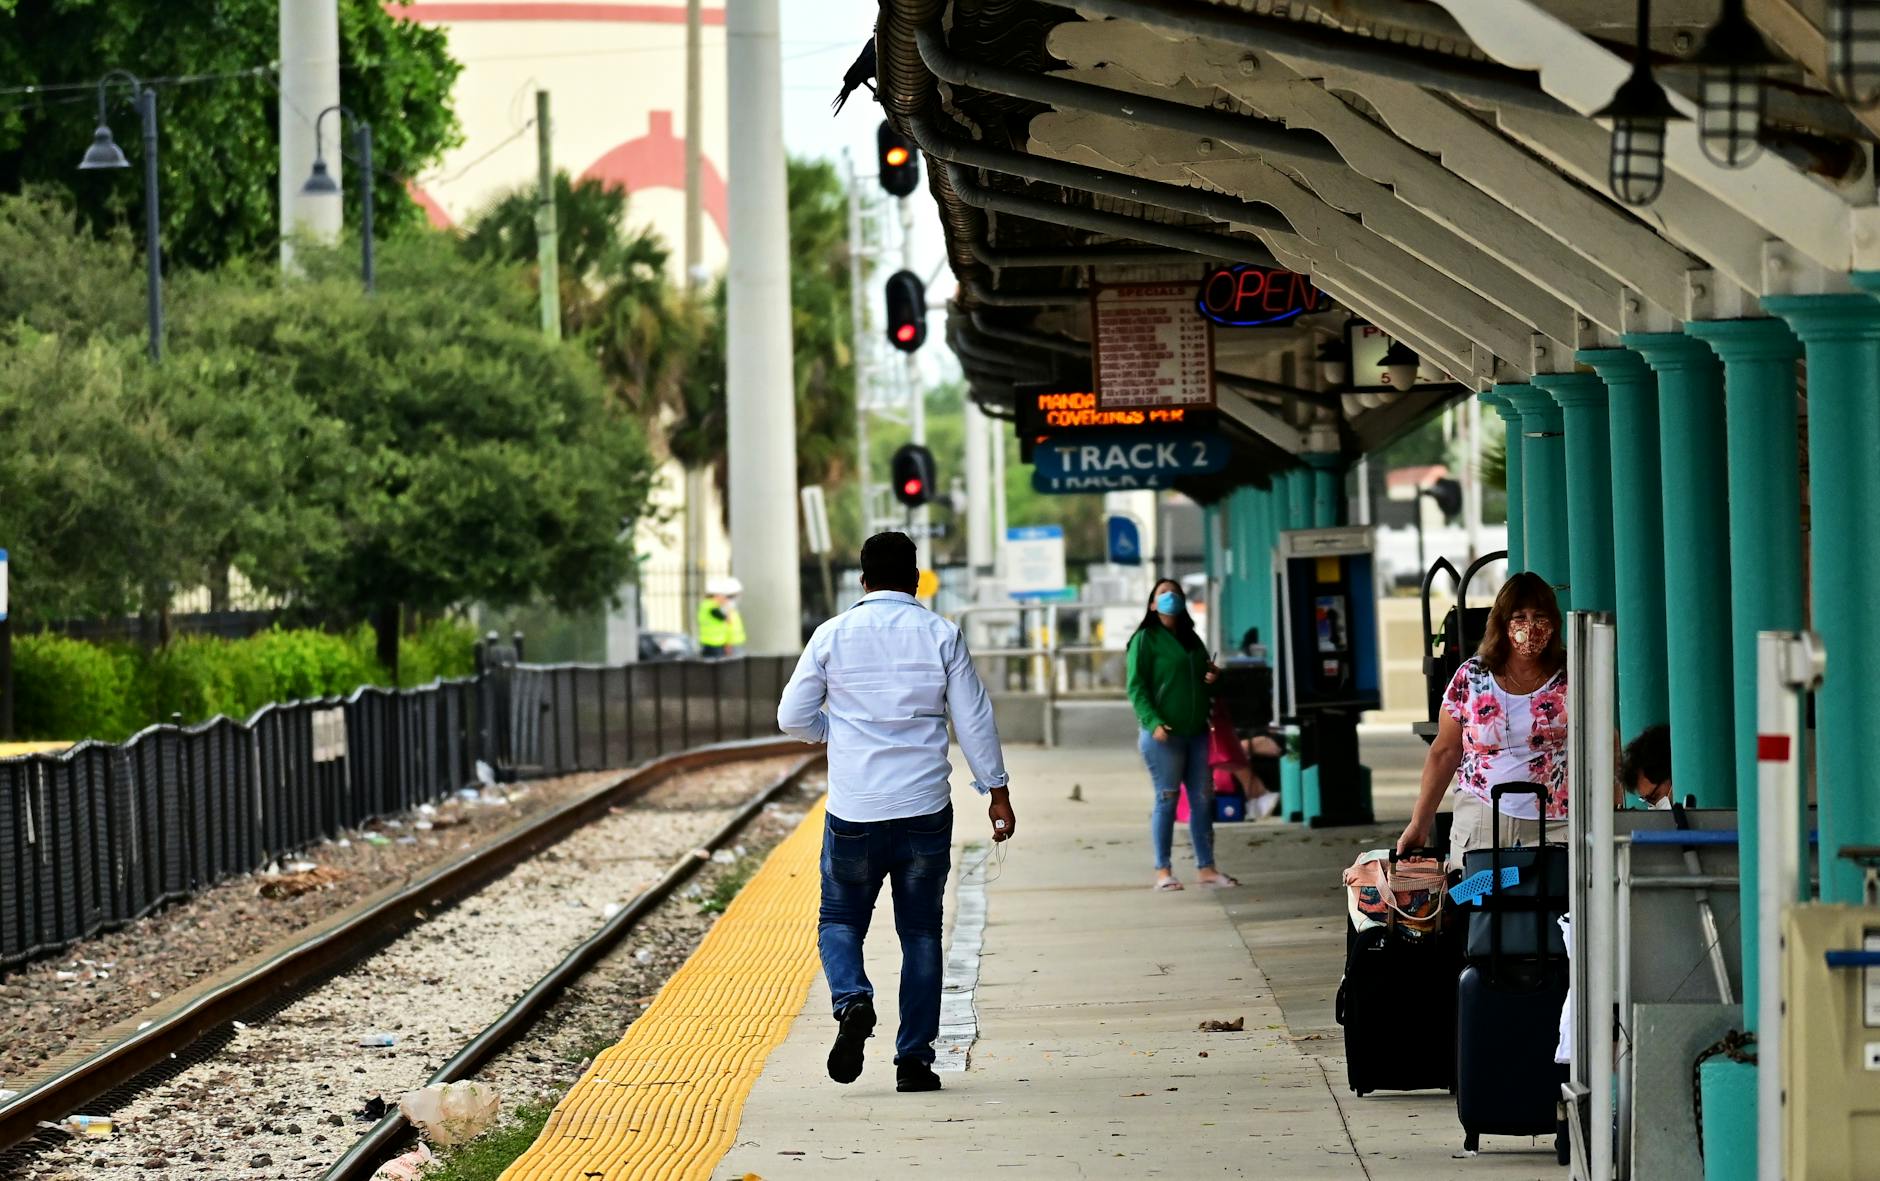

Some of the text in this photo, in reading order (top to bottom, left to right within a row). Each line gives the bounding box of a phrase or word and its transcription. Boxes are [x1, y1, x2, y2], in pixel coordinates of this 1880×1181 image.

[1118, 287, 1186, 297] SPECIALS
[1206, 271, 1317, 312] OPEN
[1054, 441, 1209, 472] TRACK 2
